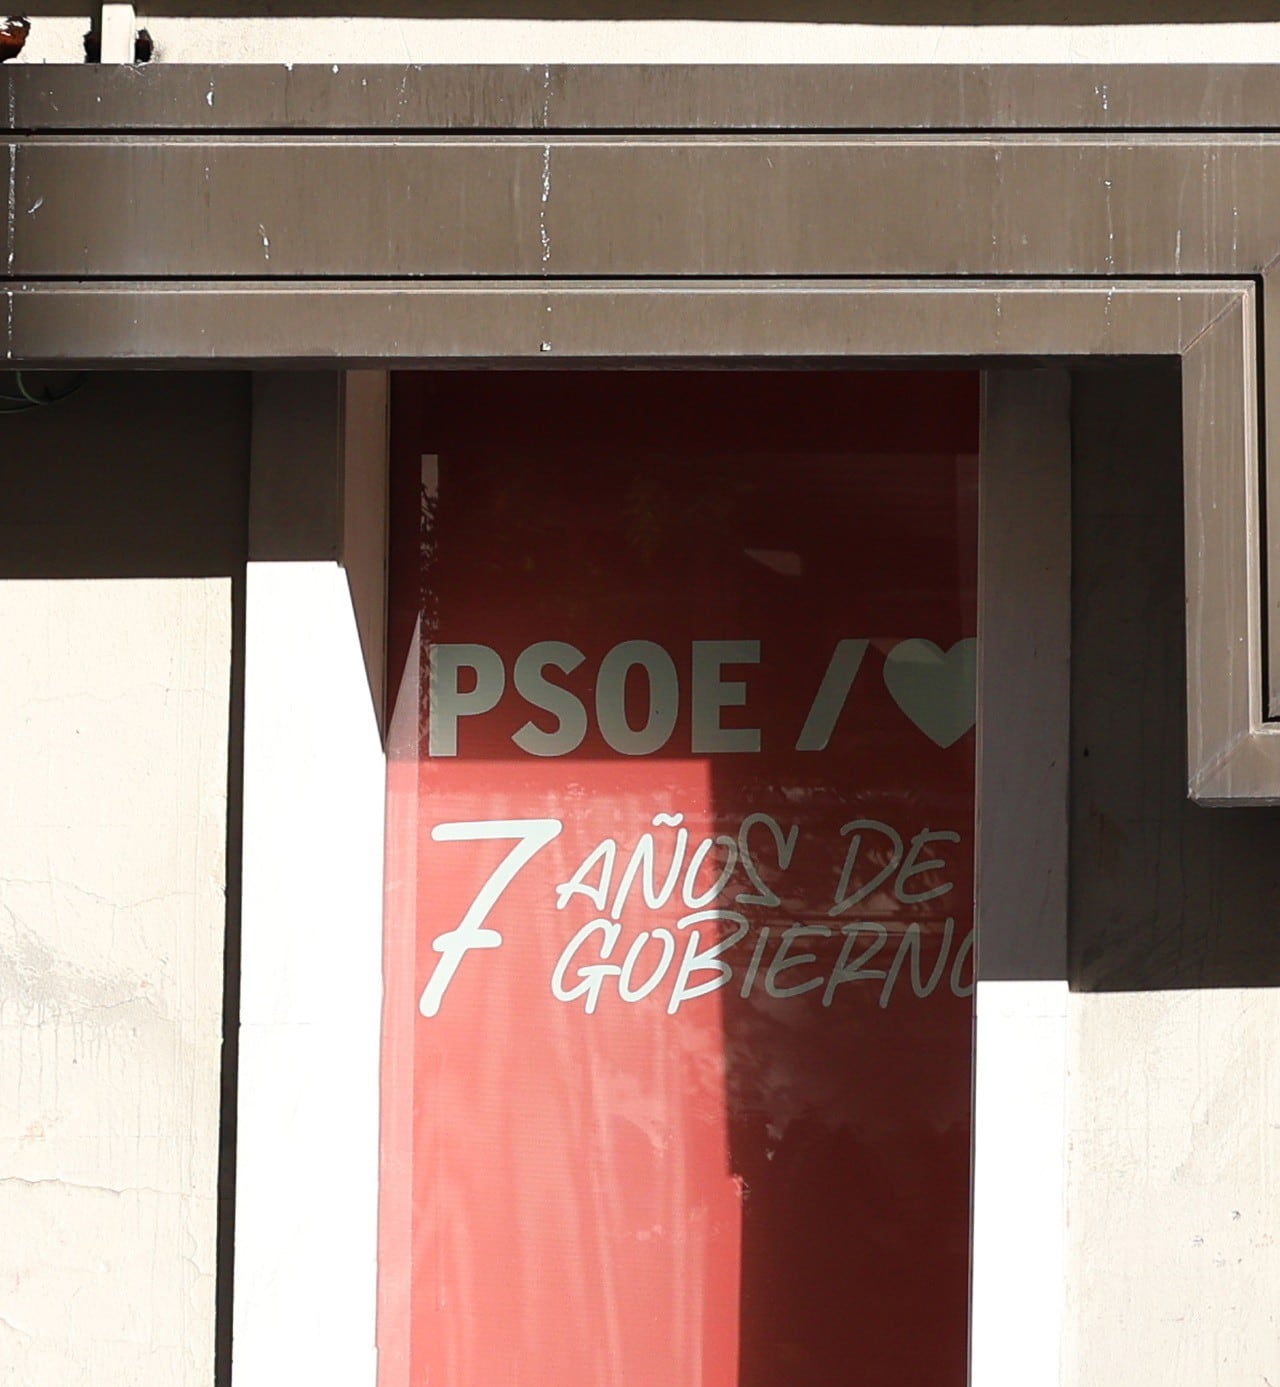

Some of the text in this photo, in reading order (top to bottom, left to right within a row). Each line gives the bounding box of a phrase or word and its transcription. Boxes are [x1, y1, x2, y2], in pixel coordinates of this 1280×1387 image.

[428, 639, 762, 758] PSOE
[418, 812, 961, 1018] 7 AÑOS DE
